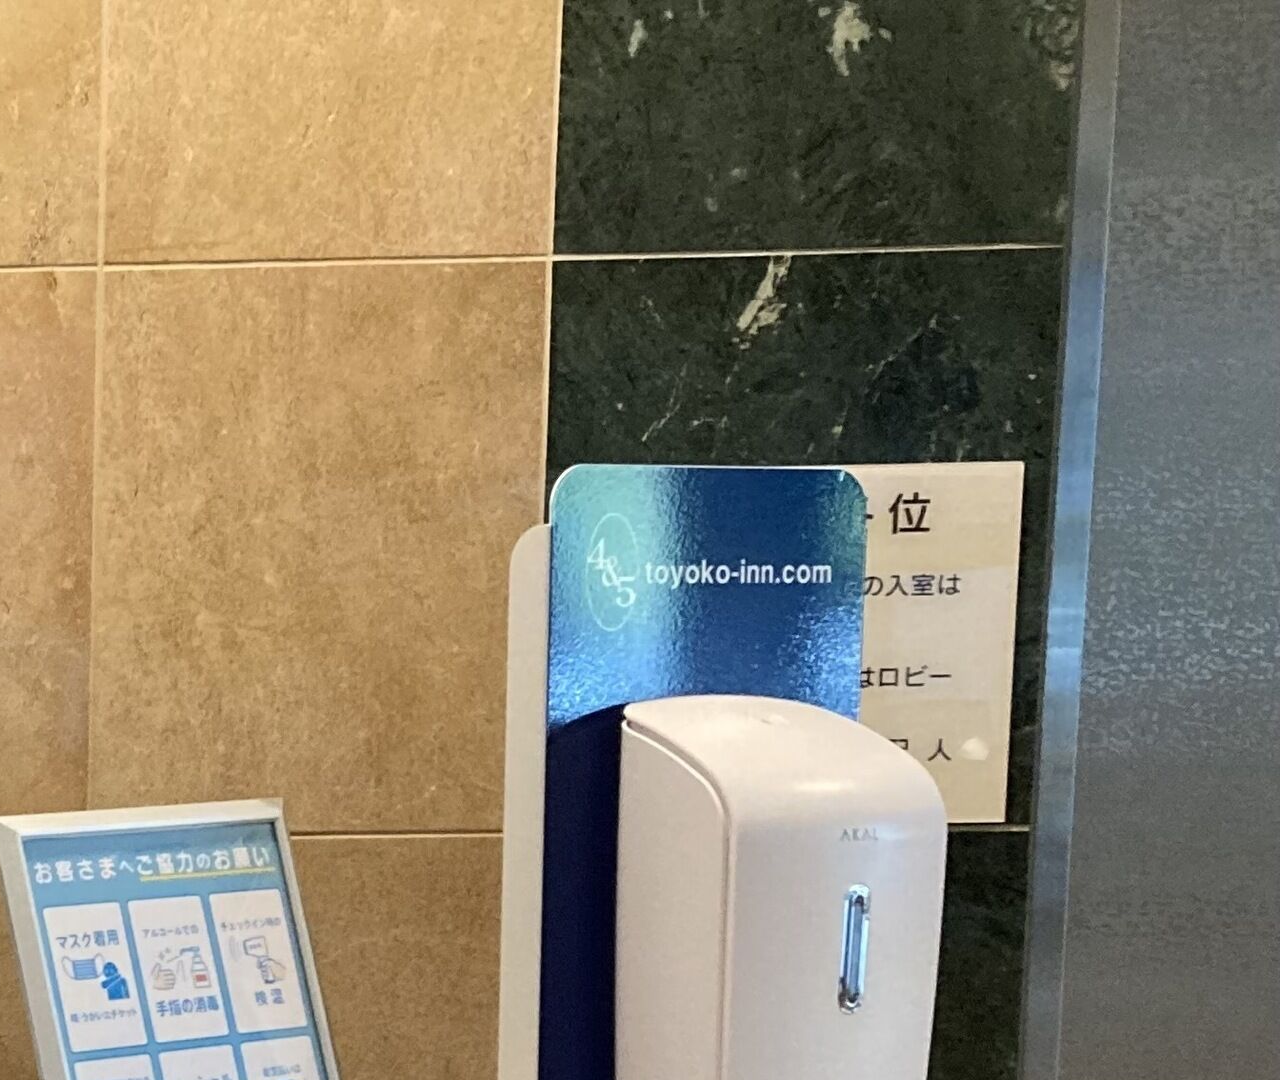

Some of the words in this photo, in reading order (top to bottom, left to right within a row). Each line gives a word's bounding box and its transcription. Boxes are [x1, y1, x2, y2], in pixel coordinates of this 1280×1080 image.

[645, 558, 833, 589] toyoko-inn.com
[56, 929, 121, 949] マスク着用
[142, 924, 200, 939] アルコールでの
[156, 995, 220, 1017] 手指の消毒
